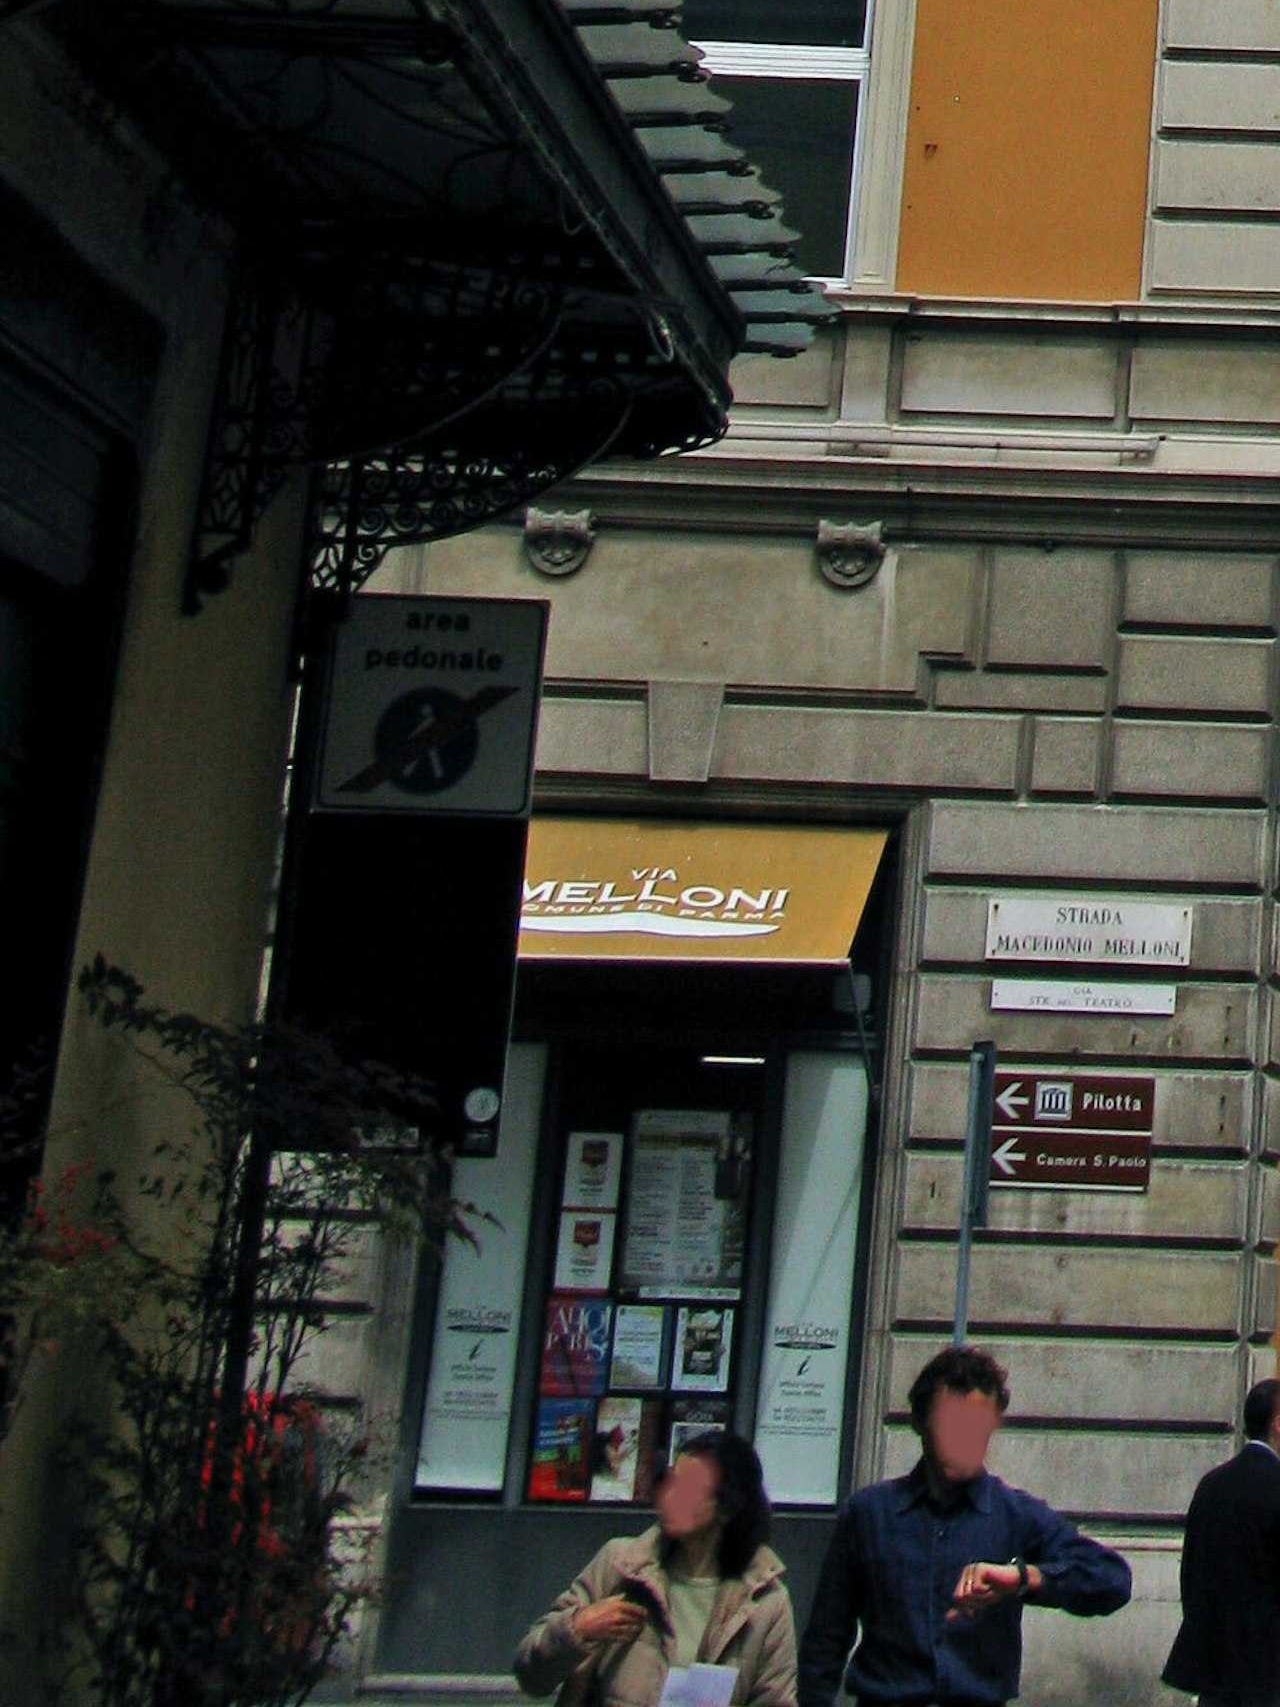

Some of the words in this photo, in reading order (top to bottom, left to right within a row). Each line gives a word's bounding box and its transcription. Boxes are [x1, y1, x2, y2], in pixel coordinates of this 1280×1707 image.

[407, 611, 470, 631] area
[365, 645, 503, 671] pedonale
[631, 867, 678, 881] VIA
[523, 879, 790, 911] MELLONI
[523, 904, 626, 913] OMUNE
[678, 909, 785, 920] PARMA
[1056, 907, 1123, 925] STRADA
[997, 935, 1092, 953] MACEDONIO
[1105, 939, 1180, 957] MELLONI
[1084, 997, 1132, 1008] TEATRO
[1083, 1092, 1142, 1111] Pilotta
[1036, 1154, 1087, 1167] Camera
[774, 1326, 838, 1338] MELLONI
